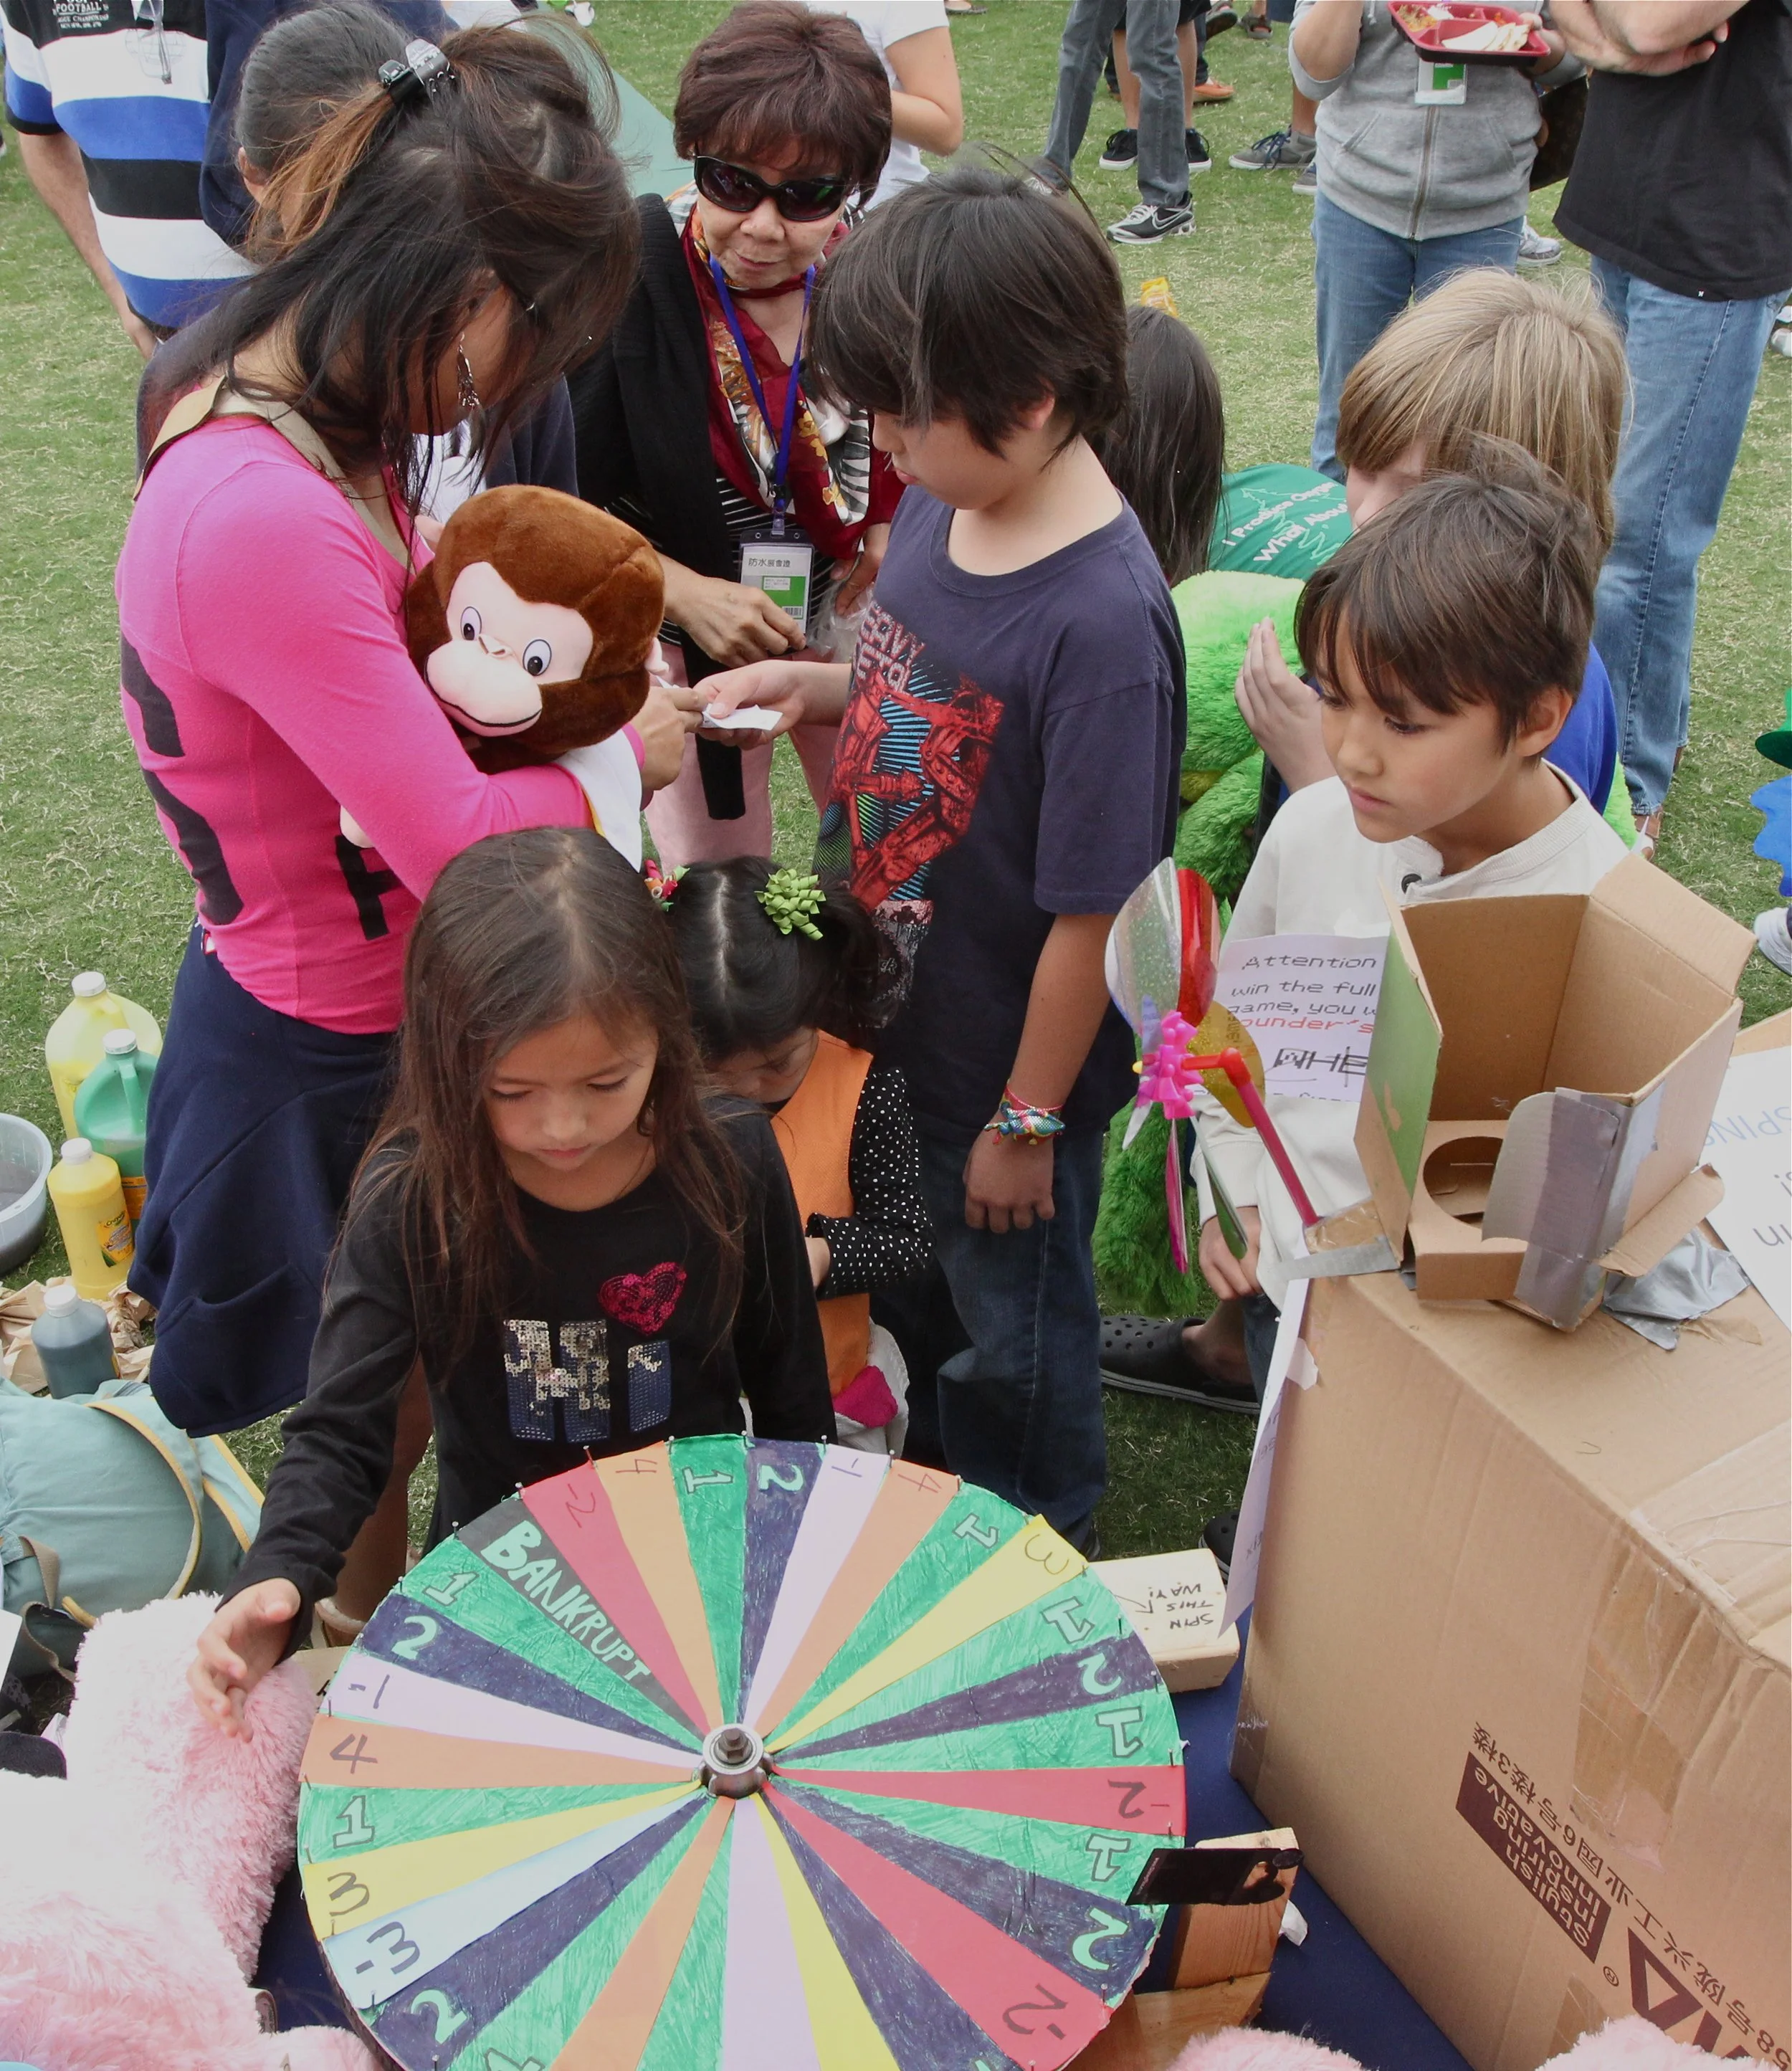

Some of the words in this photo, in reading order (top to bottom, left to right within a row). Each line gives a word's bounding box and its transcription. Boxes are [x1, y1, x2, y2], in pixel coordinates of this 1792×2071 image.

[55, 2, 102, 12] FOOTBALL
[1253, 525, 1306, 561] What
[1303, 500, 1348, 526] Abou
[1241, 954, 1376, 970] Attention
[1231, 983, 1269, 997] win
[1279, 979, 1324, 993] the
[1333, 981, 1377, 996] full
[1307, 1003, 1356, 1015] you
[616, 1458, 657, 1474] 4
[682, 1467, 734, 1493] 1
[758, 1463, 804, 1493] 2
[897, 1473, 943, 1494] 4
[953, 1513, 1000, 1549] 1
[1024, 1533, 1070, 1575] 3
[426, 1572, 479, 1607] 1
[480, 1520, 652, 1682] BANKRUPT
[1148, 1583, 1201, 1599] WAY!
[1166, 1599, 1214, 1611] THIS
[391, 1616, 442, 1660] 2
[1041, 1596, 1095, 1644] 1
[1169, 1613, 1214, 1629] SPIN
[348, 1675, 390, 1710] -1
[1079, 1653, 1123, 1695] 2
[329, 1733, 378, 1774] 4
[1095, 1707, 1145, 1758] 1
[1107, 1779, 1170, 1819] -2
[333, 1795, 376, 1848] 1
[1474, 1766, 1603, 1913] Innovative
[1085, 1834, 1133, 1882] 1
[1493, 1805, 1597, 1933] Inspiring
[328, 1872, 370, 1916] 3
[1506, 1844, 1591, 1948] Stylish
[355, 1921, 421, 1974] -3
[1072, 1908, 1129, 1971] 2
[411, 1989, 467, 2044] 2
[1002, 1984, 1069, 2040] -2
